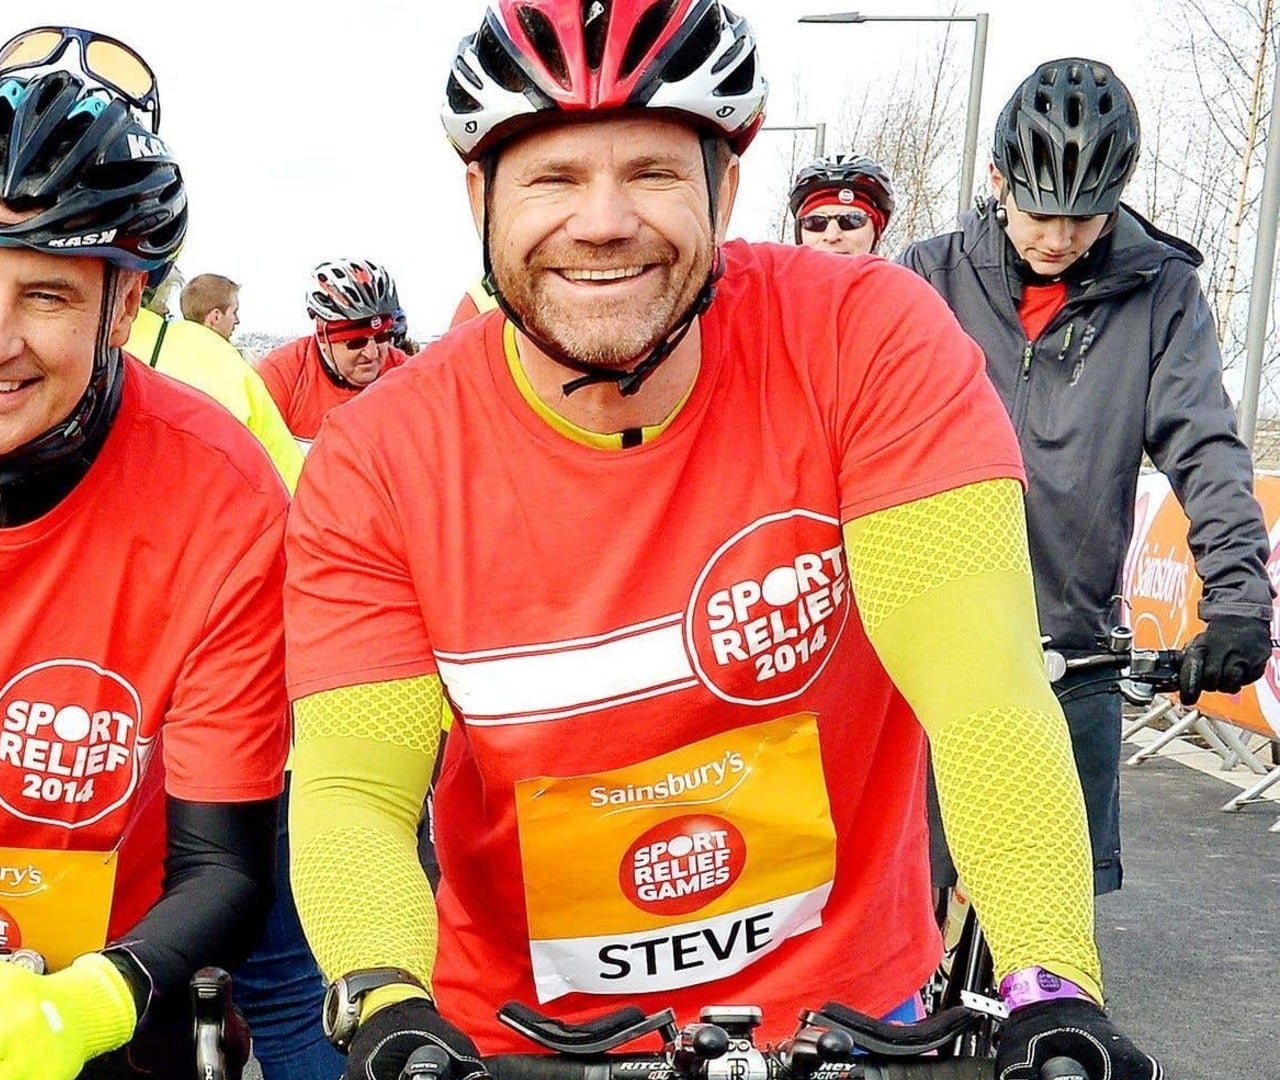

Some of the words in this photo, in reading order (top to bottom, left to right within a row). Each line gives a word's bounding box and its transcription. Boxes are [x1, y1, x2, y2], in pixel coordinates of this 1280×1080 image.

[706, 545, 842, 631] SPORT
[711, 570, 845, 665] RELIEF
[755, 624, 827, 681] 2014
[3, 700, 134, 745] SPORT
[22, 773, 94, 803] 2014
[590, 751, 744, 807] Sainsbury's
[634, 830, 729, 867] SPORT
[634, 849, 731, 886] RELIEF
[636, 866, 730, 902] GAMES
[598, 911, 774, 980] STEVE
